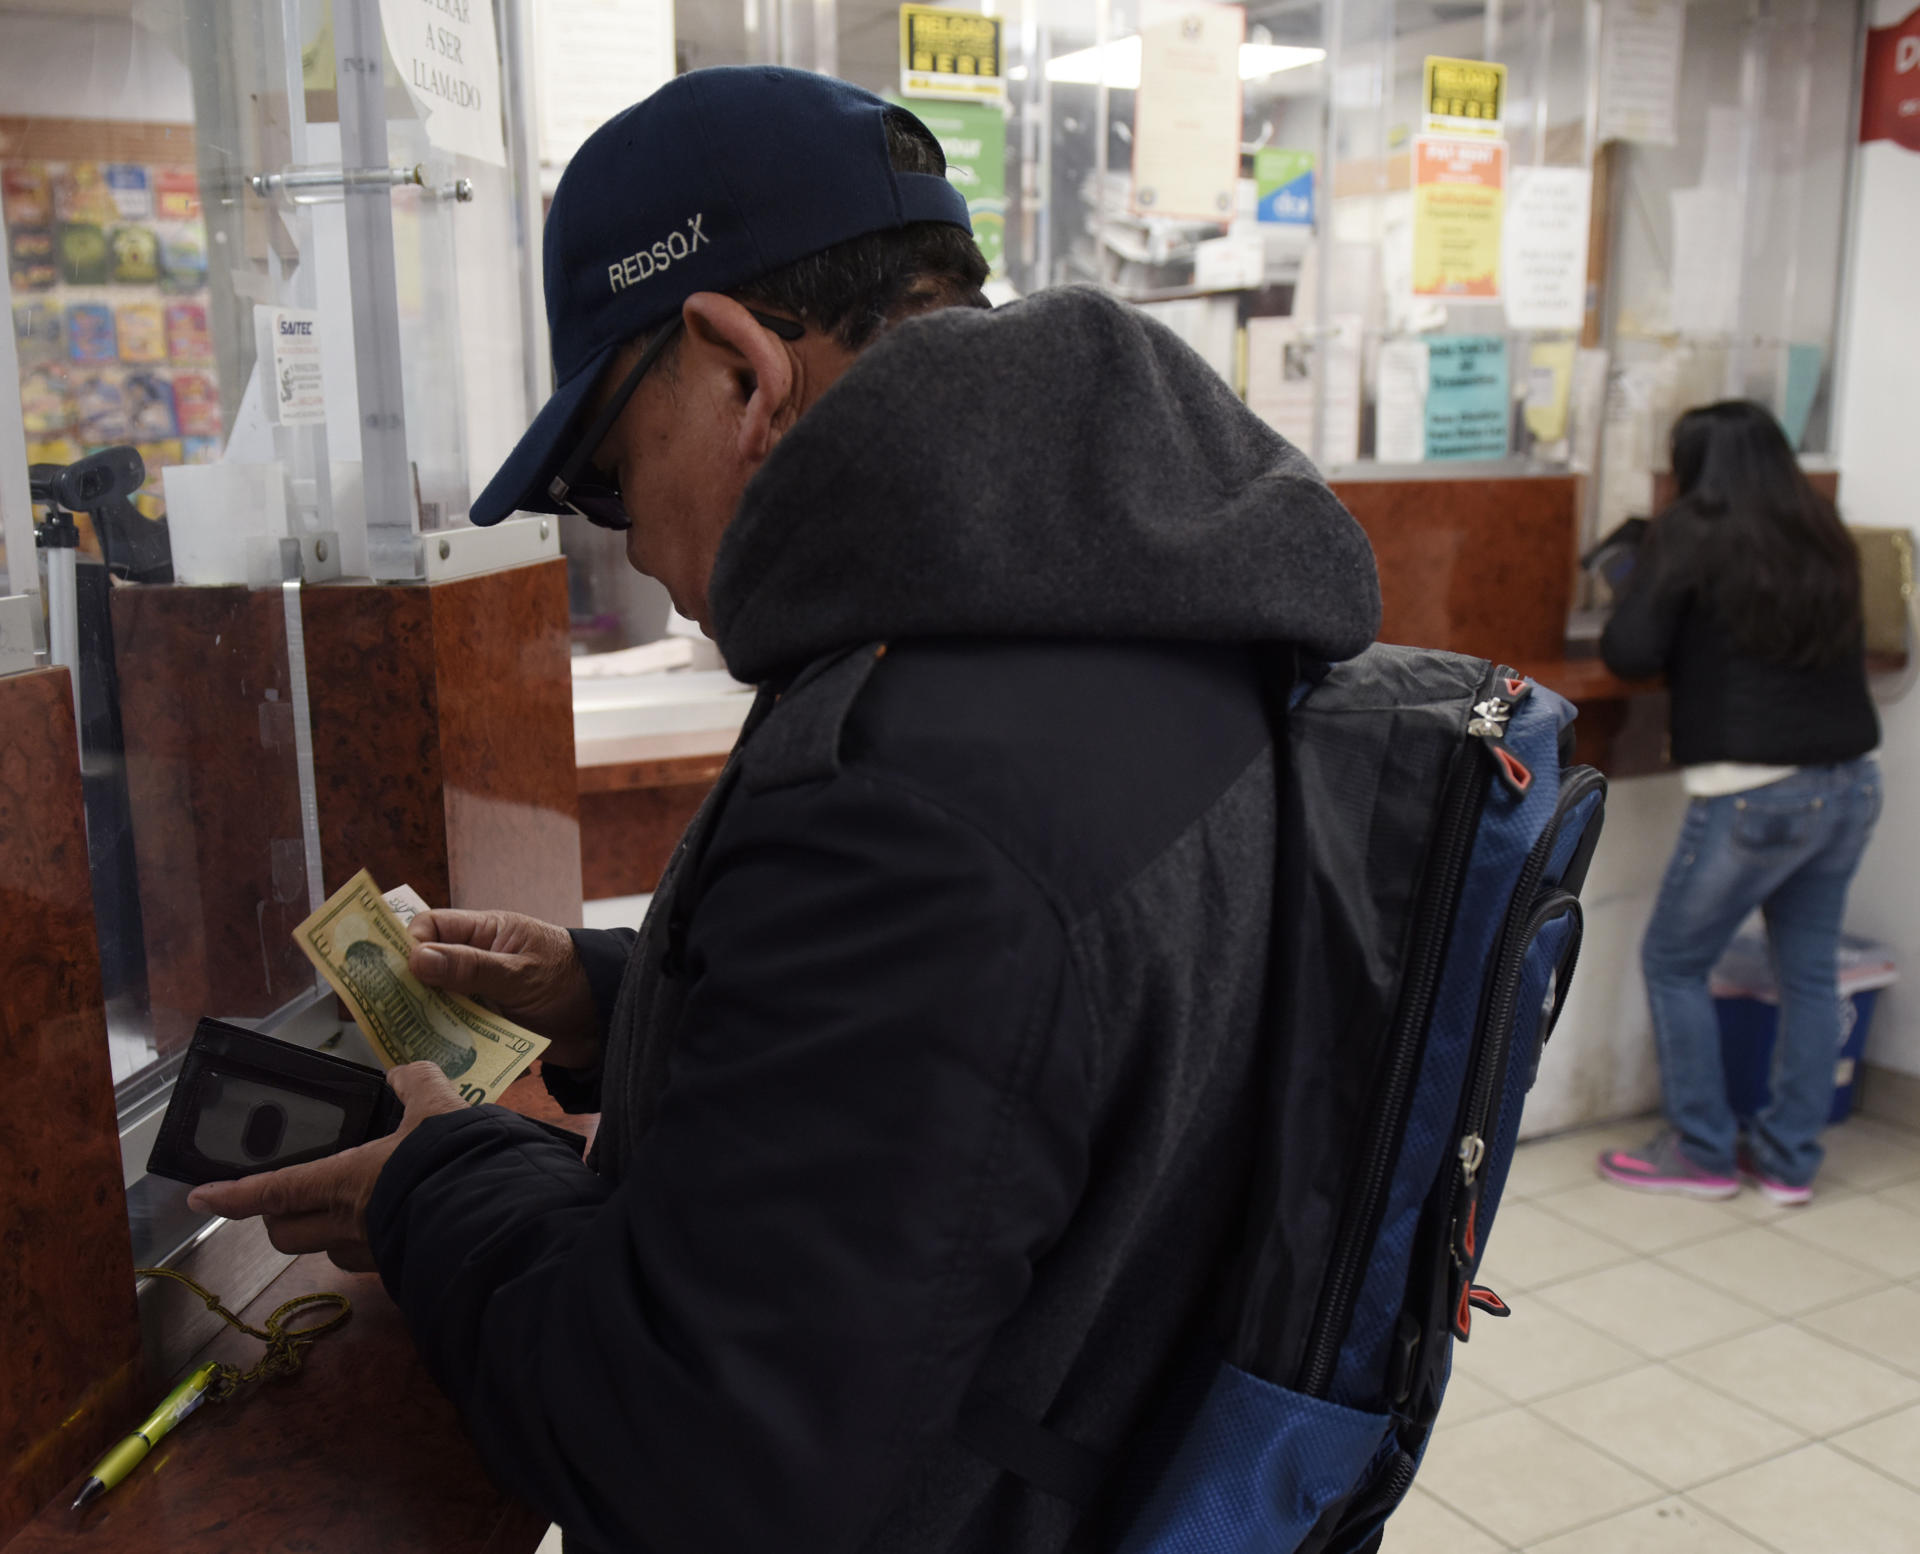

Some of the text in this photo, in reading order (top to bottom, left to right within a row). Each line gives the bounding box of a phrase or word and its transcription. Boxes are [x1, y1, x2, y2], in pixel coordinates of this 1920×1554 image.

[425, 23, 464, 65] A SER
[413, 58, 481, 112] LLAMADO
[459, 1083, 486, 1107] 10
